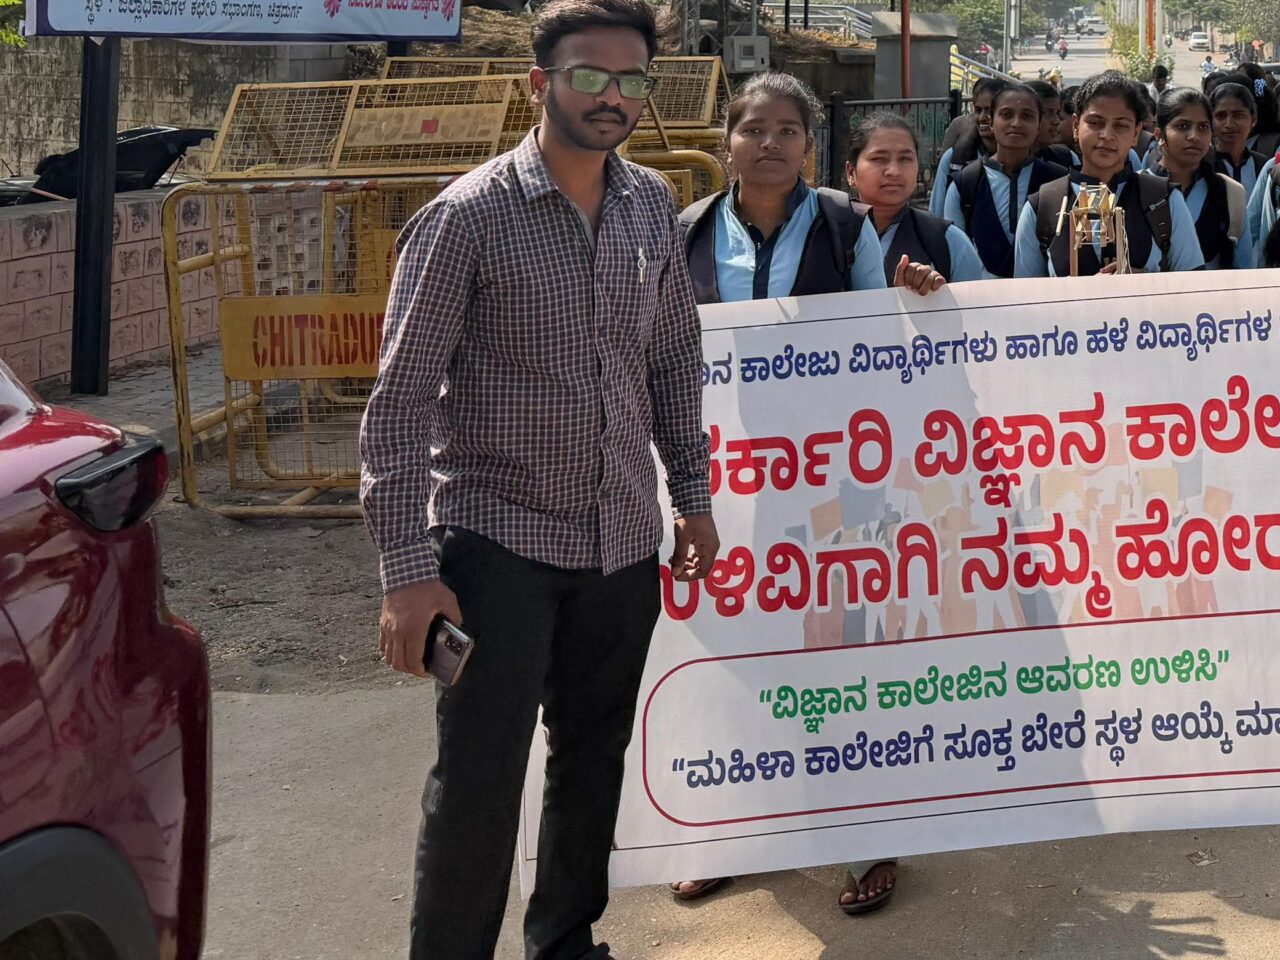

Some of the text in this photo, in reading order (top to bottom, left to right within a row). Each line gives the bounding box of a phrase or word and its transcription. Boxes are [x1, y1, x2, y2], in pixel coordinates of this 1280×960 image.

[221, 0, 263, 20] ಸಭಾಂಗಣ,
[267, 2, 303, 24] ಚಿತ್ರದುರ್ಗ
[738, 341, 842, 385] ಕಾಲೇಜು
[848, 328, 1000, 385] ವಿದ್ಯಾರ್ಥಿಗಳು
[1004, 323, 1079, 363] ಹಾಗೂ
[1084, 315, 1131, 356] ಹಳೆ
[1134, 308, 1274, 364] ವಿದ್ಯಾರ್ಥಿಗಳ
[912, 388, 1108, 510] ವಿಜ್ಞಾನ
[958, 510, 1114, 620] ನಮ್ಮ
[875, 660, 1009, 712] ಕಾಲೇಜಿನ
[1014, 653, 1122, 696] ಆವರಣ
[803, 722, 936, 777] ಕಾಲೇಜಿಗೆ
[942, 716, 1017, 773] ಸೂಕ್ತ
[1020, 707, 1087, 753] ಬೇರೆ
[1093, 706, 1144, 768] ಸ್ಥಳ
[1149, 699, 1234, 755] ಆಯ್ಕೆ
